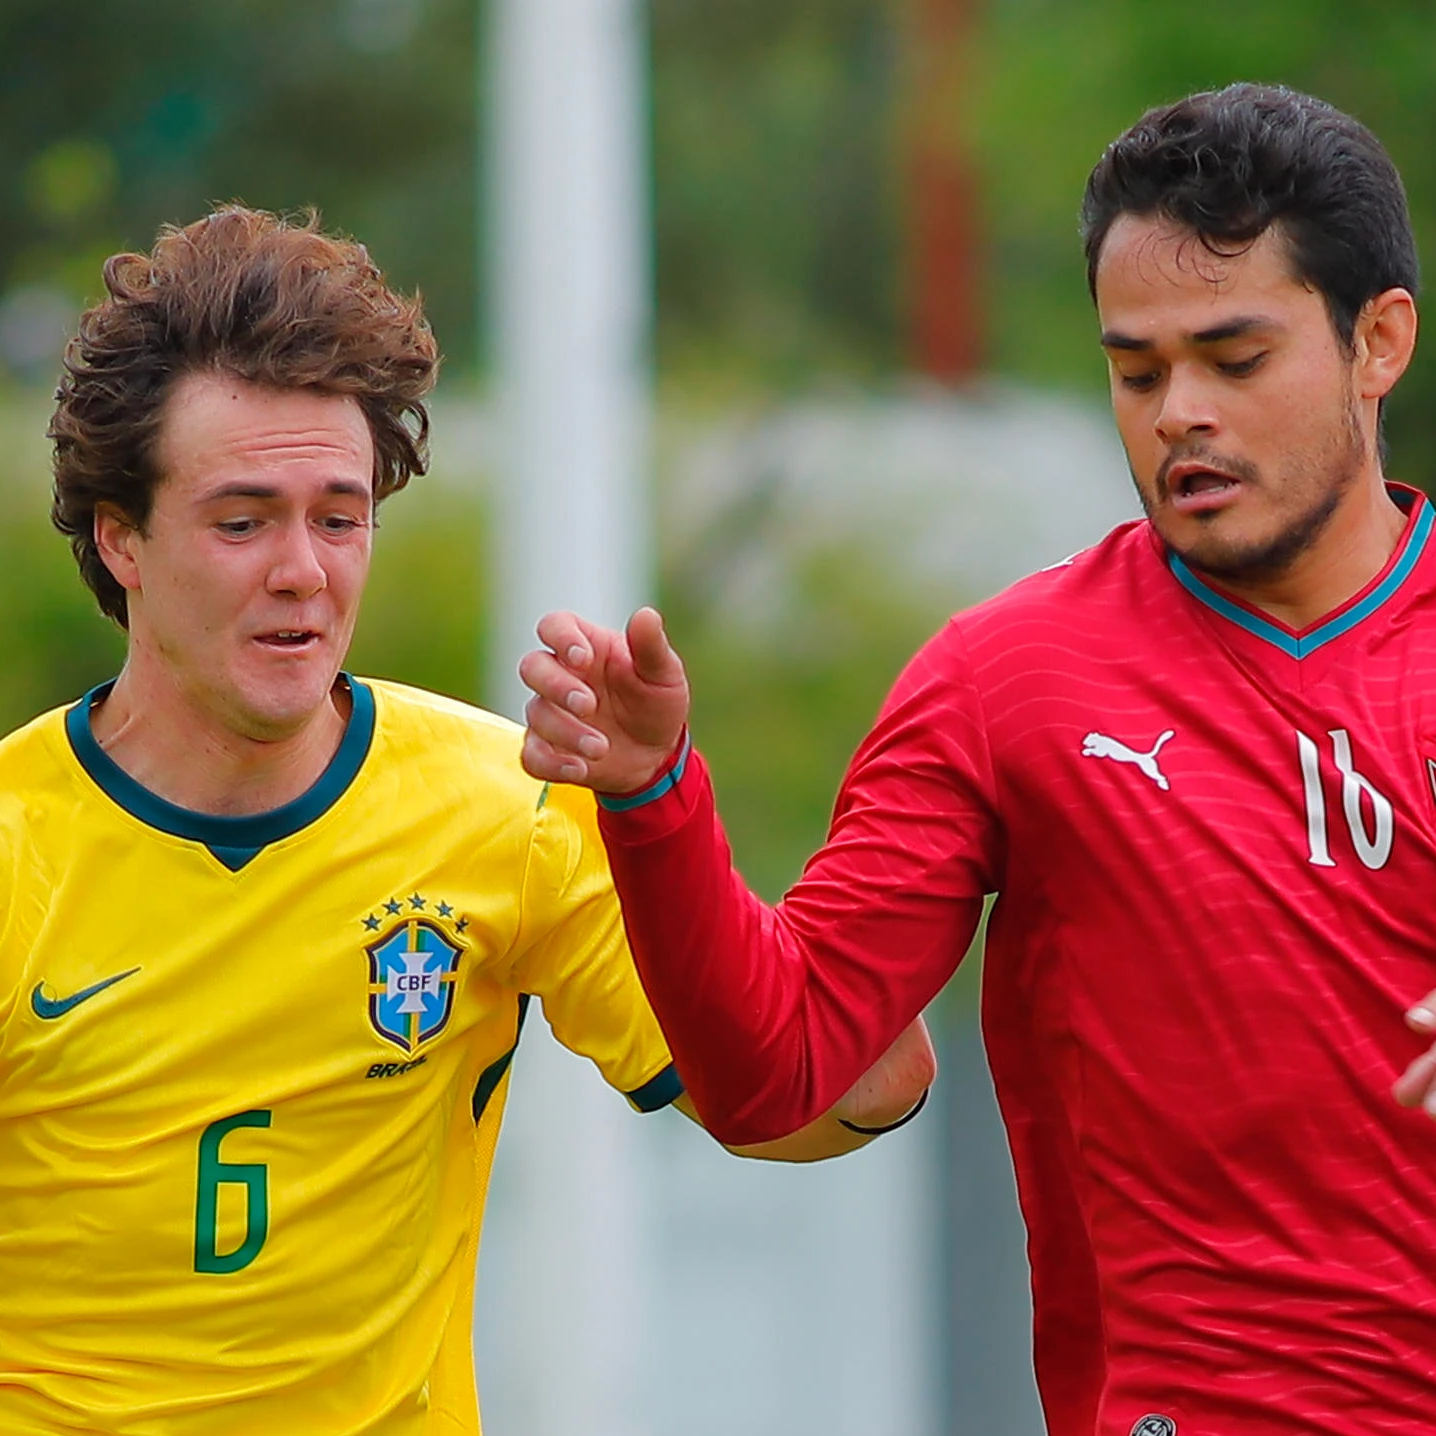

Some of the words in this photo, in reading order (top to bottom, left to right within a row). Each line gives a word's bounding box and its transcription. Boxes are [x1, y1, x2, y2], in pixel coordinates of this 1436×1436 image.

[1296, 729, 1393, 869] 16
[397, 975, 431, 991] CBF
[194, 1110, 271, 1274] 6
